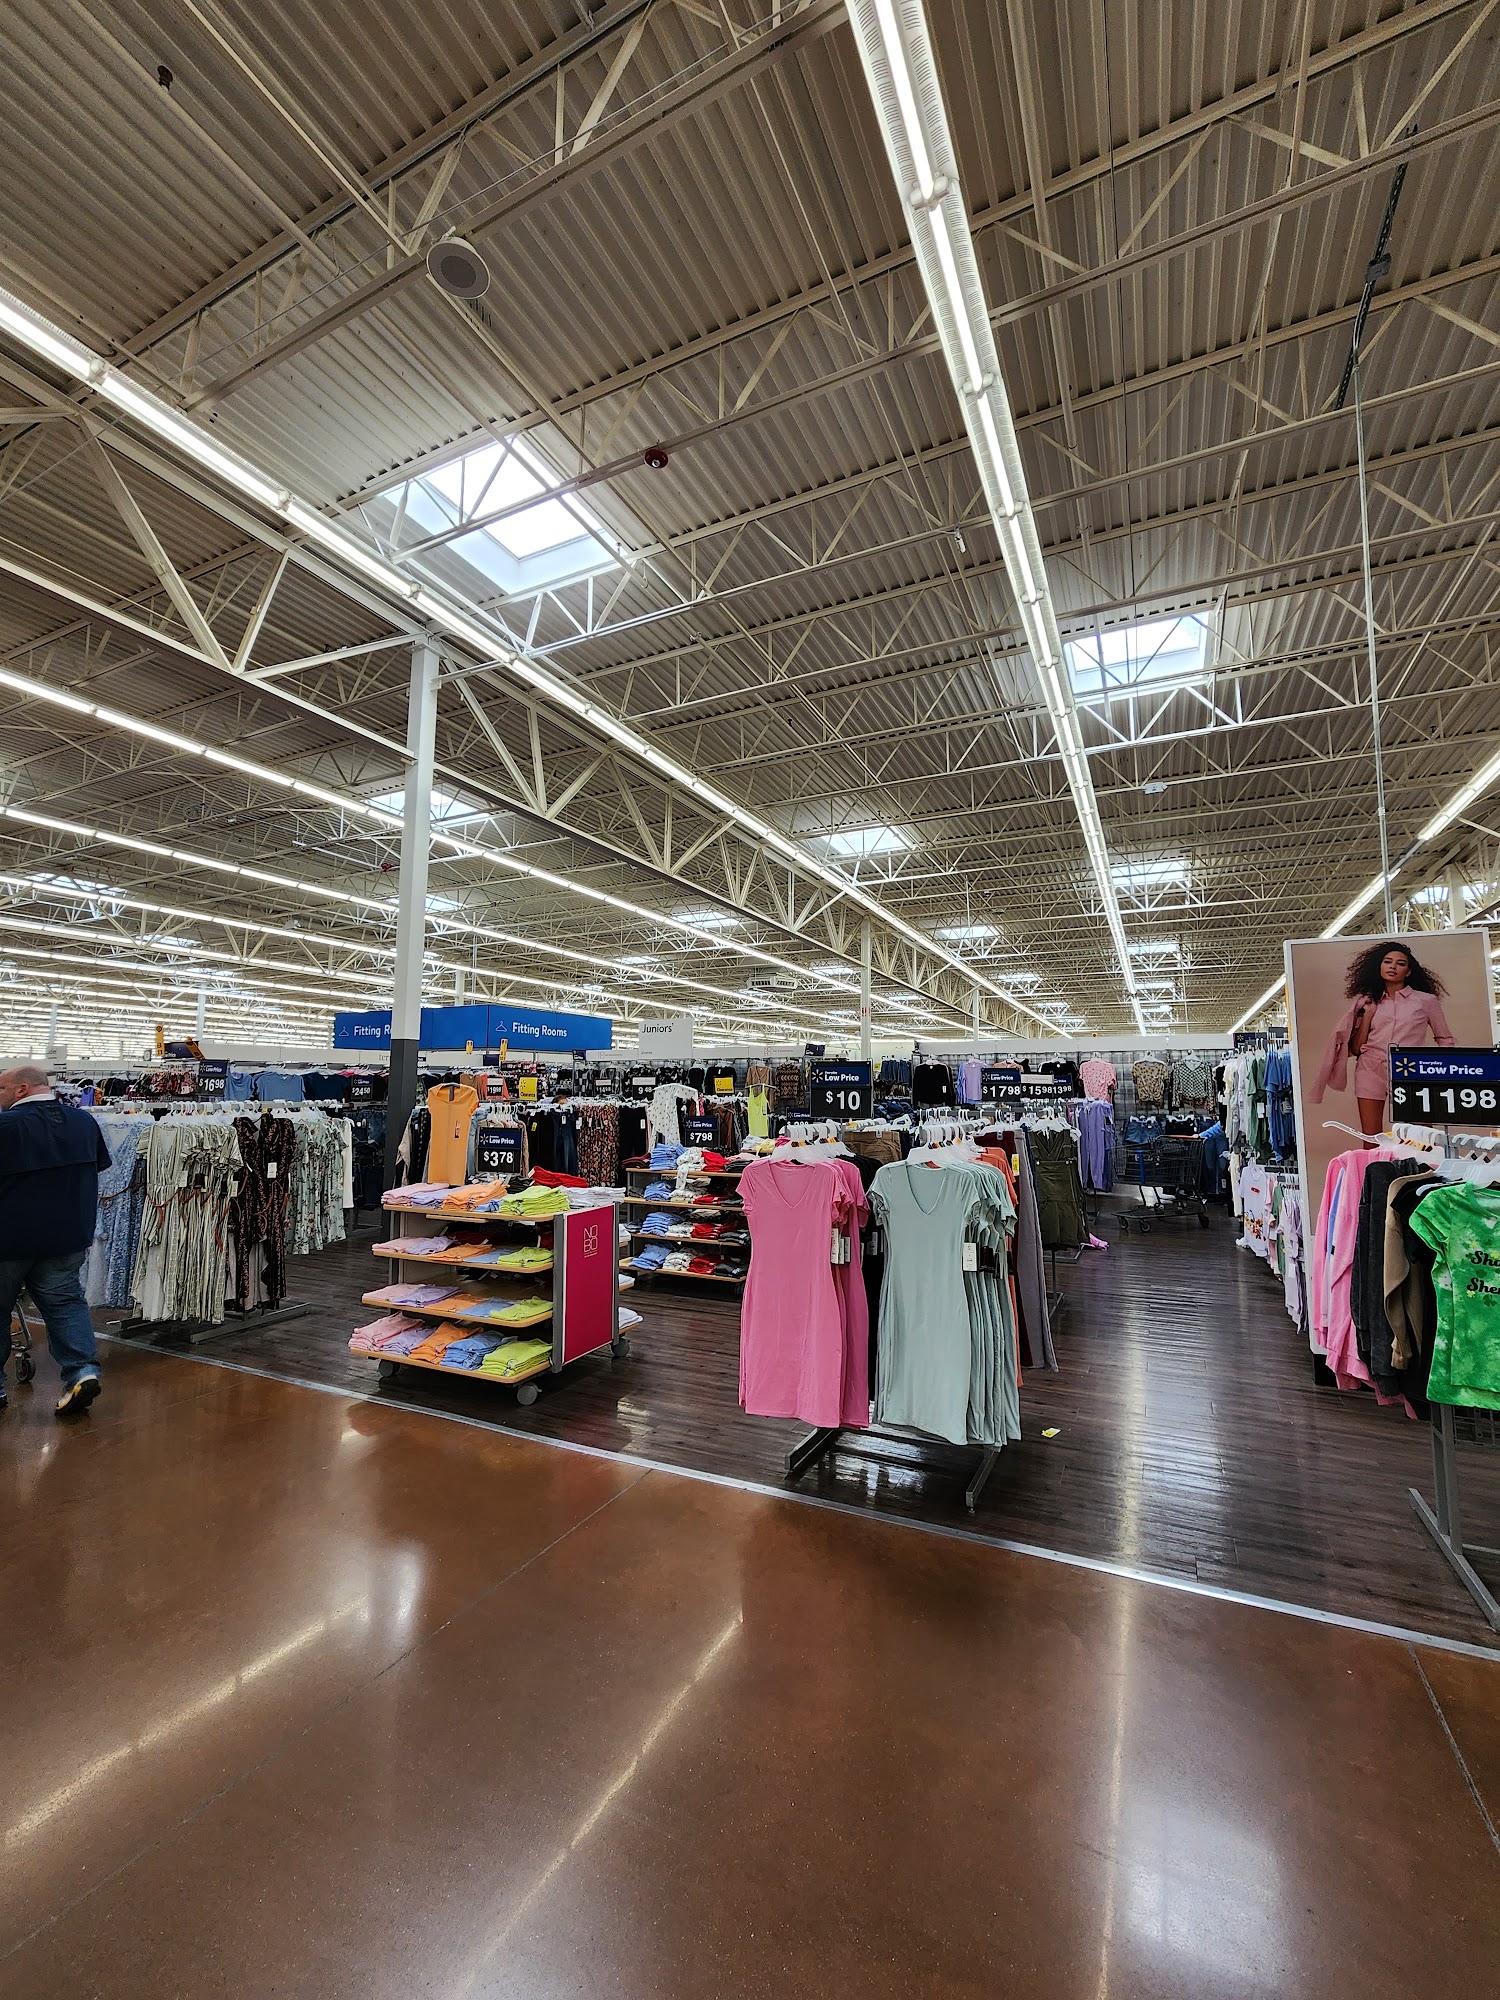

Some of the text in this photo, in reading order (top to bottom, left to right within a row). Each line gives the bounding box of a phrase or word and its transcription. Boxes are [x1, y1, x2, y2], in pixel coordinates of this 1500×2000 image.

[353, 1024, 381, 1038] Fitting
[512, 1022, 568, 1038] Fitting Rooms
[1419, 1065, 1484, 1075] Low Price
[840, 1074, 860, 1082] Price
[500, 1137, 515, 1145] Price
